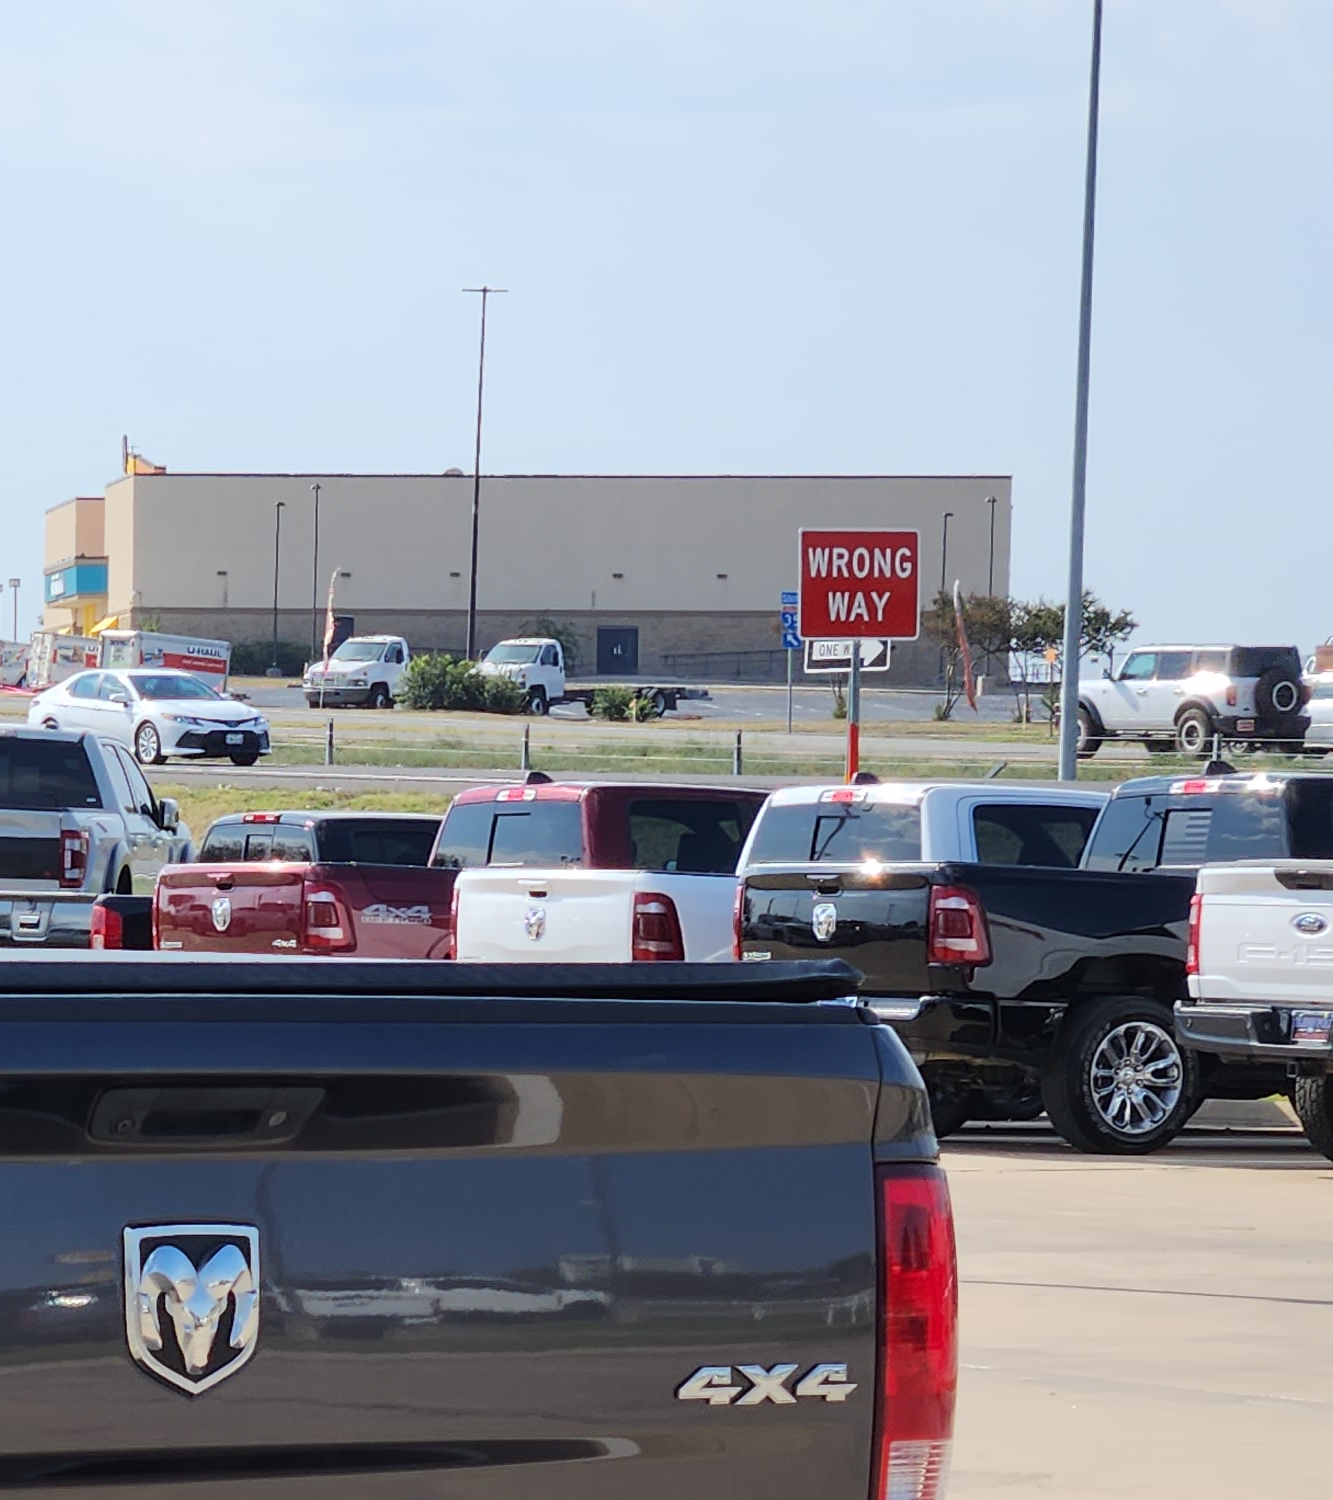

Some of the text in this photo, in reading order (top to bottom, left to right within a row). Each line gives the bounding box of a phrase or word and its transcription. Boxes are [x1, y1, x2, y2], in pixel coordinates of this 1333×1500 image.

[808, 547, 912, 579] WRONG
[828, 591, 891, 622] WAY
[819, 644, 839, 656] ONE
